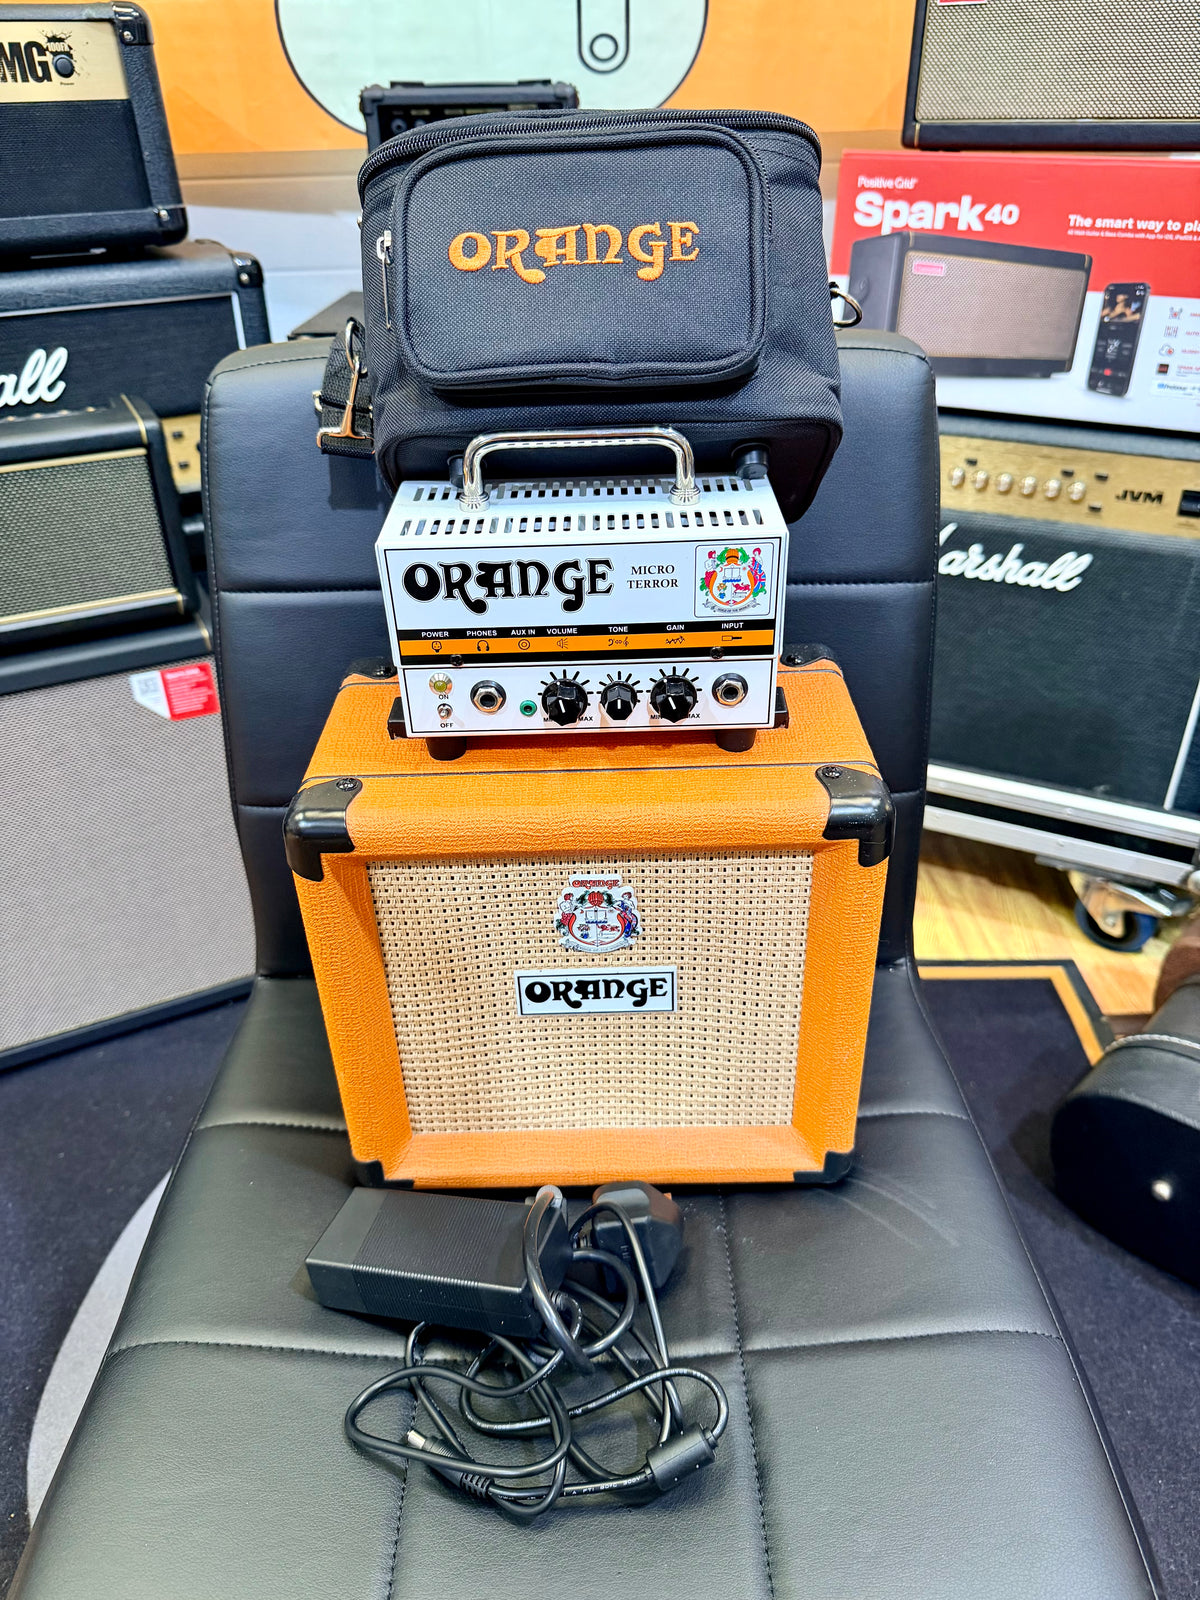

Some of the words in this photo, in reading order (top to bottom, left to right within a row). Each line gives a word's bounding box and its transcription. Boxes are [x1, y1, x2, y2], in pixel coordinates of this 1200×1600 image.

[857, 175, 894, 189] Positive
[854, 191, 986, 236] Spark
[984, 203, 1020, 226] 40
[1068, 214, 1093, 227] The
[1095, 217, 1134, 230] smart
[1136, 219, 1164, 233] way
[1166, 219, 1182, 232] to
[448, 221, 700, 284] ORANGE
[1115, 489, 1164, 504] JVM
[631, 564, 675, 576] MICRO
[402, 558, 615, 615] ORANGE
[627, 577, 679, 589] TERROR
[466, 629, 498, 637] PHONES
[546, 627, 578, 635] VOLUME
[571, 879, 620, 889] ORANGE
[525, 977, 668, 1009] ORANGE
